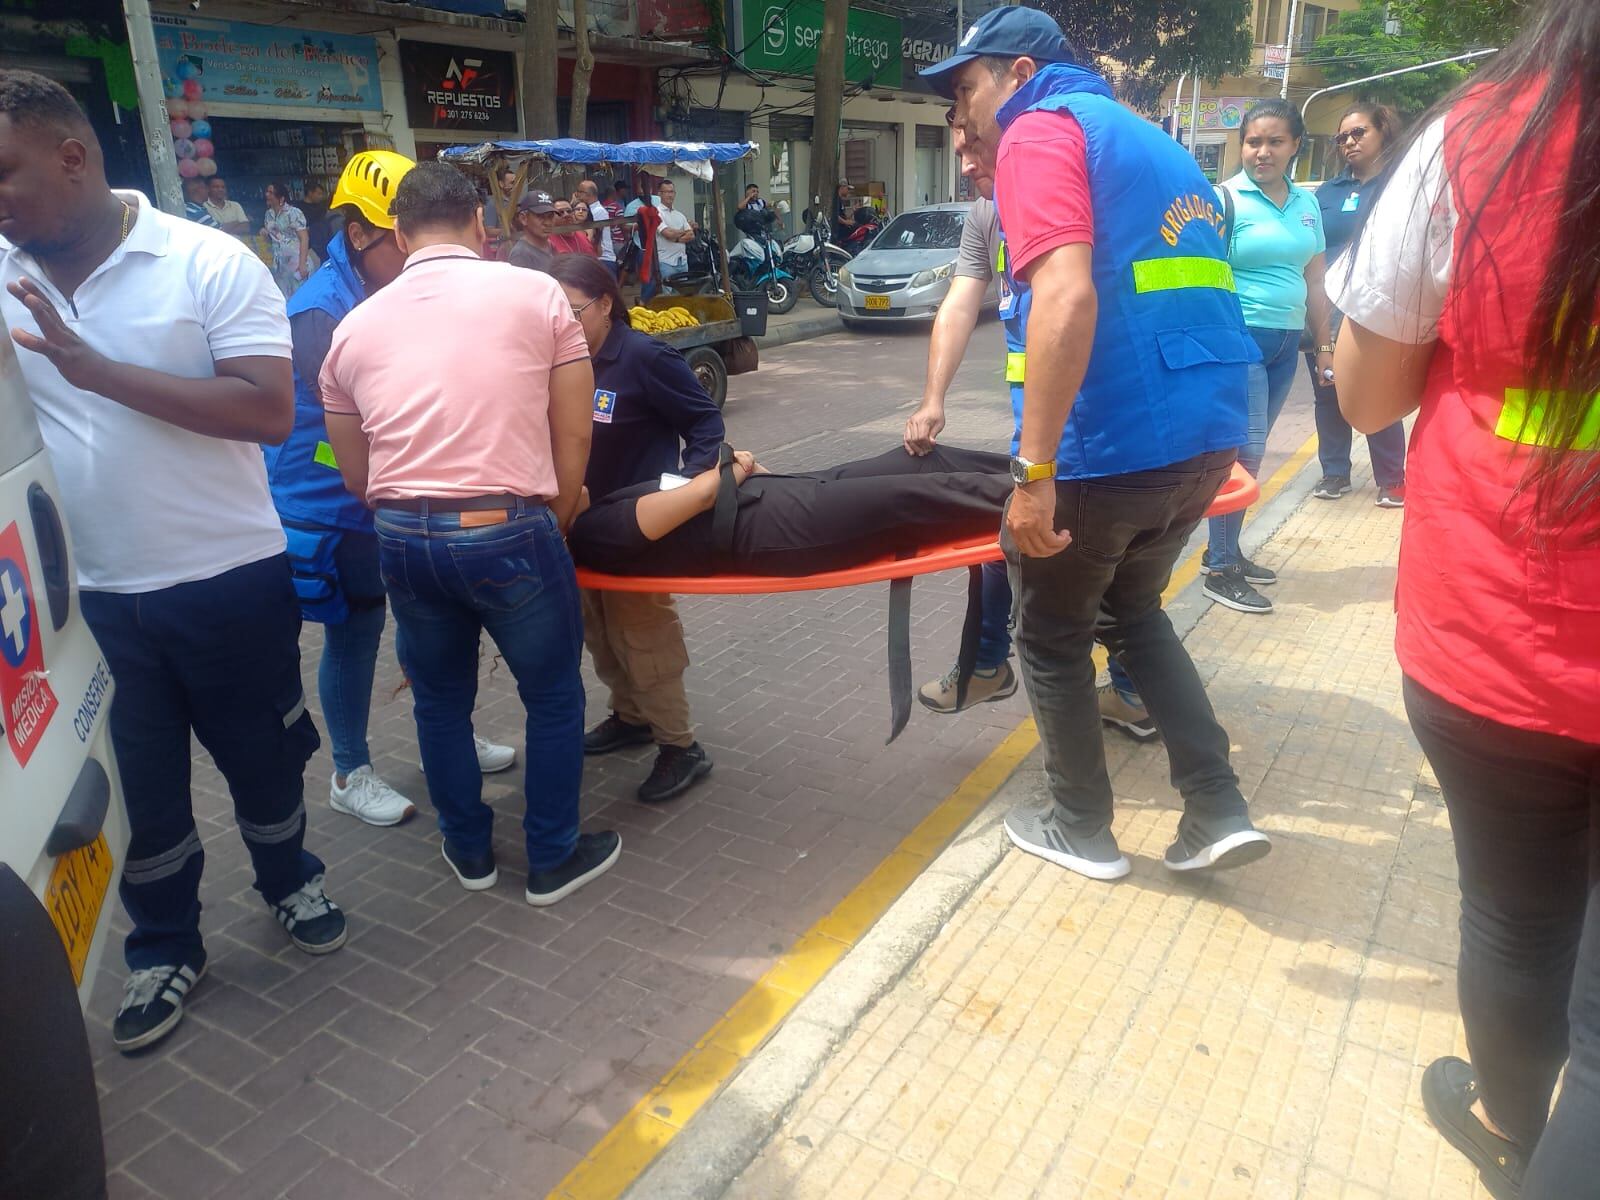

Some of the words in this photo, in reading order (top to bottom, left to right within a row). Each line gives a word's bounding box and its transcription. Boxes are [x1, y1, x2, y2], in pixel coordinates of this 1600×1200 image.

[180, 32, 260, 57] Bodega
[427, 90, 501, 109] REPUESTOS
[447, 109, 459, 119] 301
[461, 110, 473, 120] 275
[474, 111, 490, 121] 6236
[73, 660, 109, 744] CONSERVE
[13, 687, 51, 748] MEDICA
